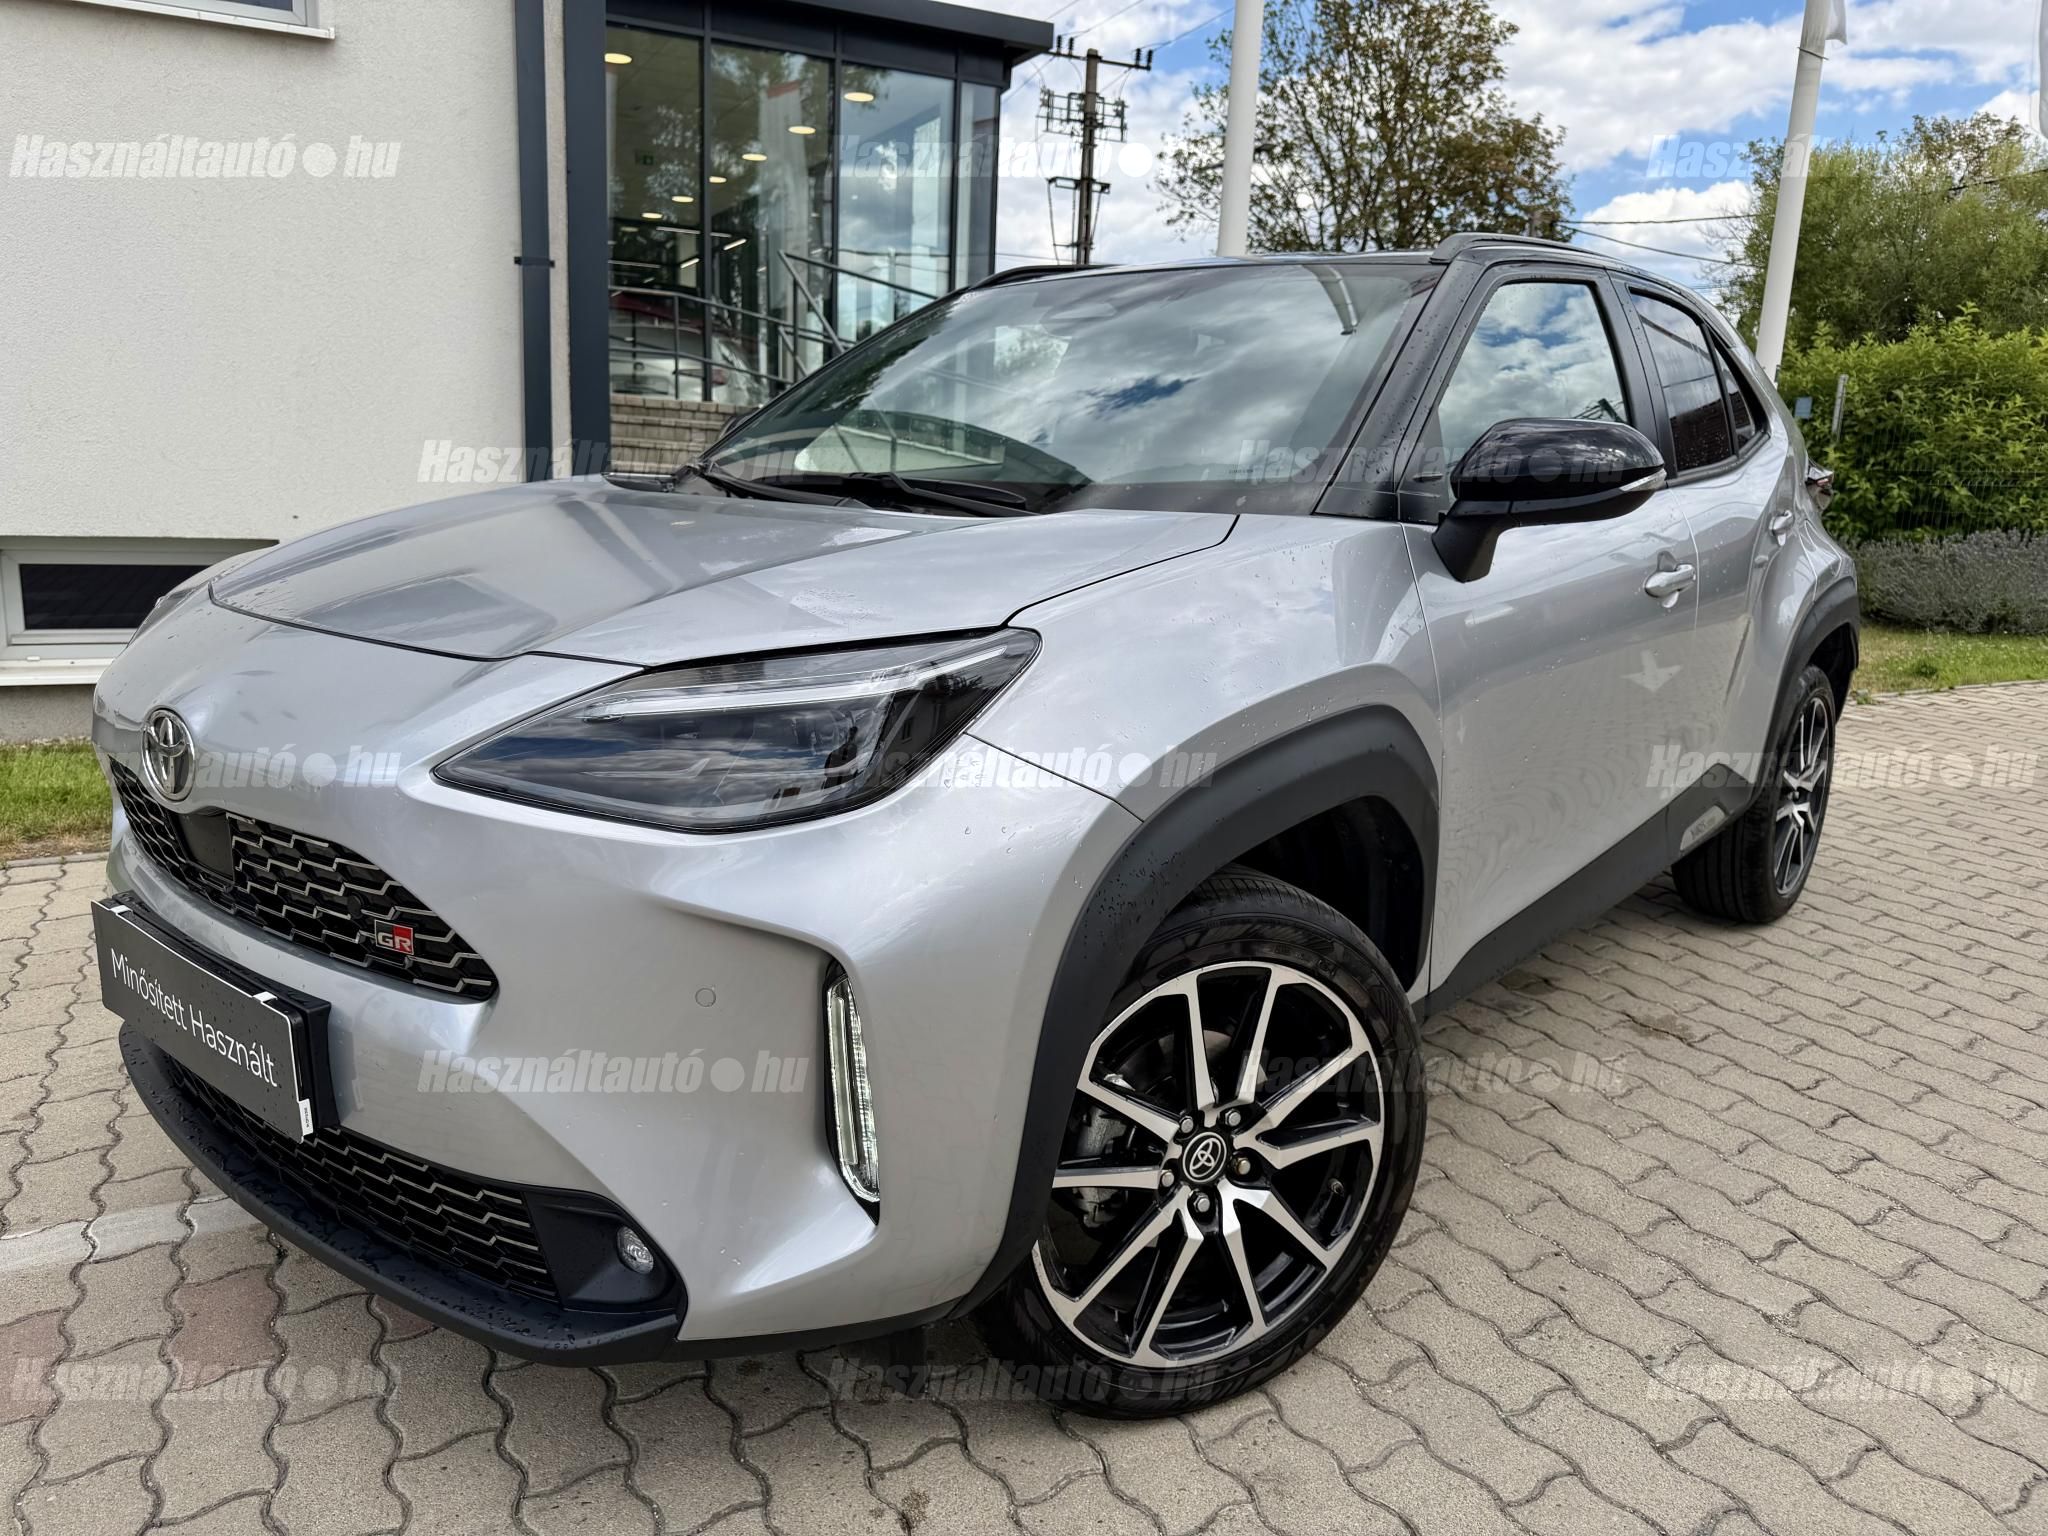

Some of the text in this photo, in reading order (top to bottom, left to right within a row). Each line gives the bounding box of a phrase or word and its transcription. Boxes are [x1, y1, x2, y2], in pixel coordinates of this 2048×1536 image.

[377, 931, 412, 953] GR
[111, 947, 278, 1088] Minősített Használt
